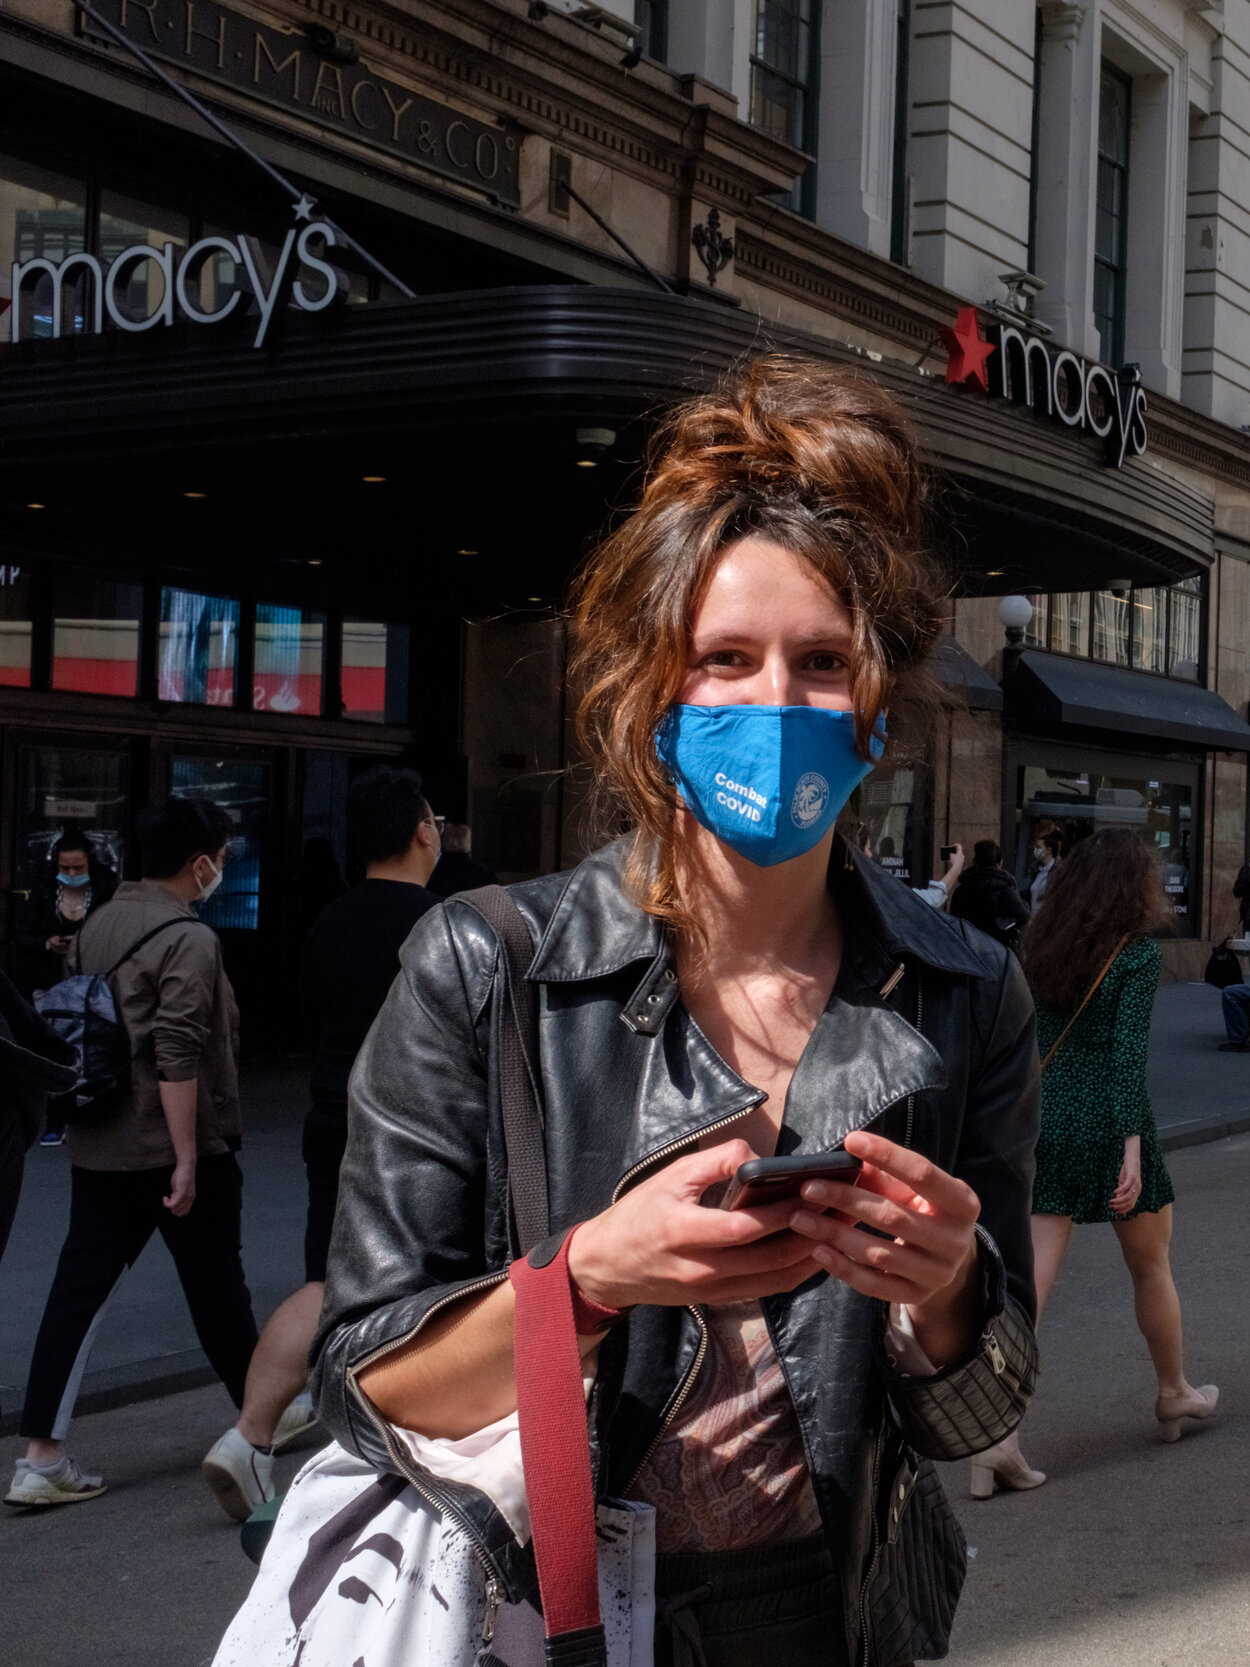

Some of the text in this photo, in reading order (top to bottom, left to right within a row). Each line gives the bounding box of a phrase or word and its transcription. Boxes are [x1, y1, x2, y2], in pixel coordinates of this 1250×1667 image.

[417, 120, 437, 157] &
[715, 772, 767, 809] Combat
[716, 791, 761, 822] COVID
